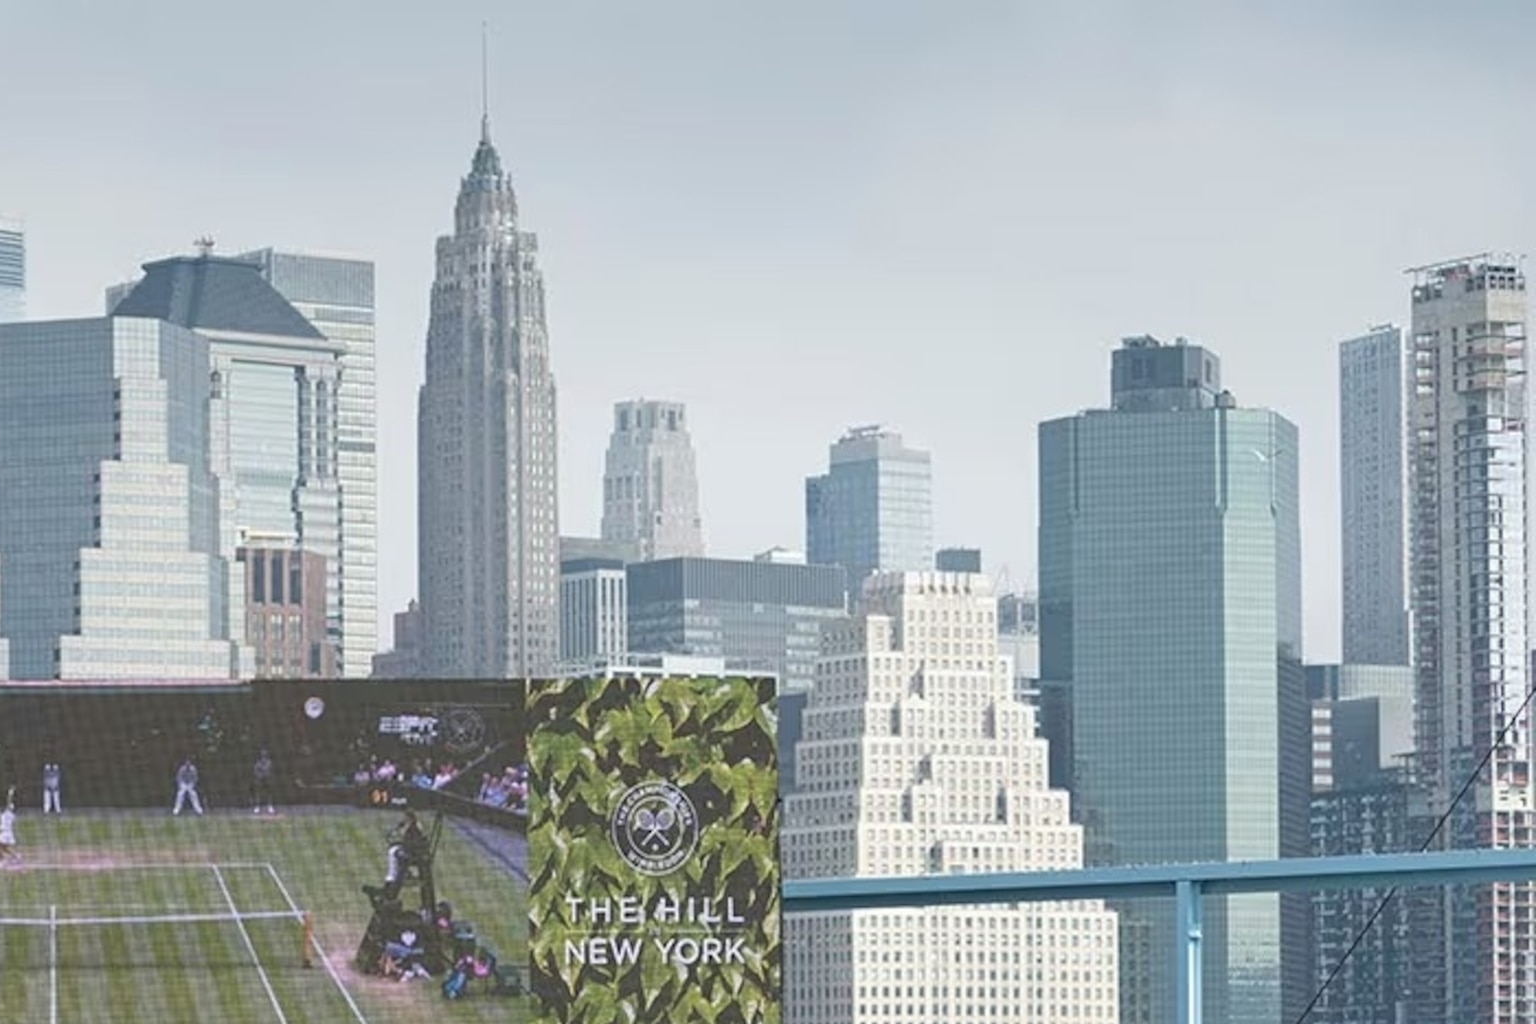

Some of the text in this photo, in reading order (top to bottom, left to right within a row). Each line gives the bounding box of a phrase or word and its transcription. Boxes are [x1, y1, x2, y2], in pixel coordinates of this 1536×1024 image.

[566, 897, 745, 923] THE HILL
[564, 938, 745, 965] NEW YORK
